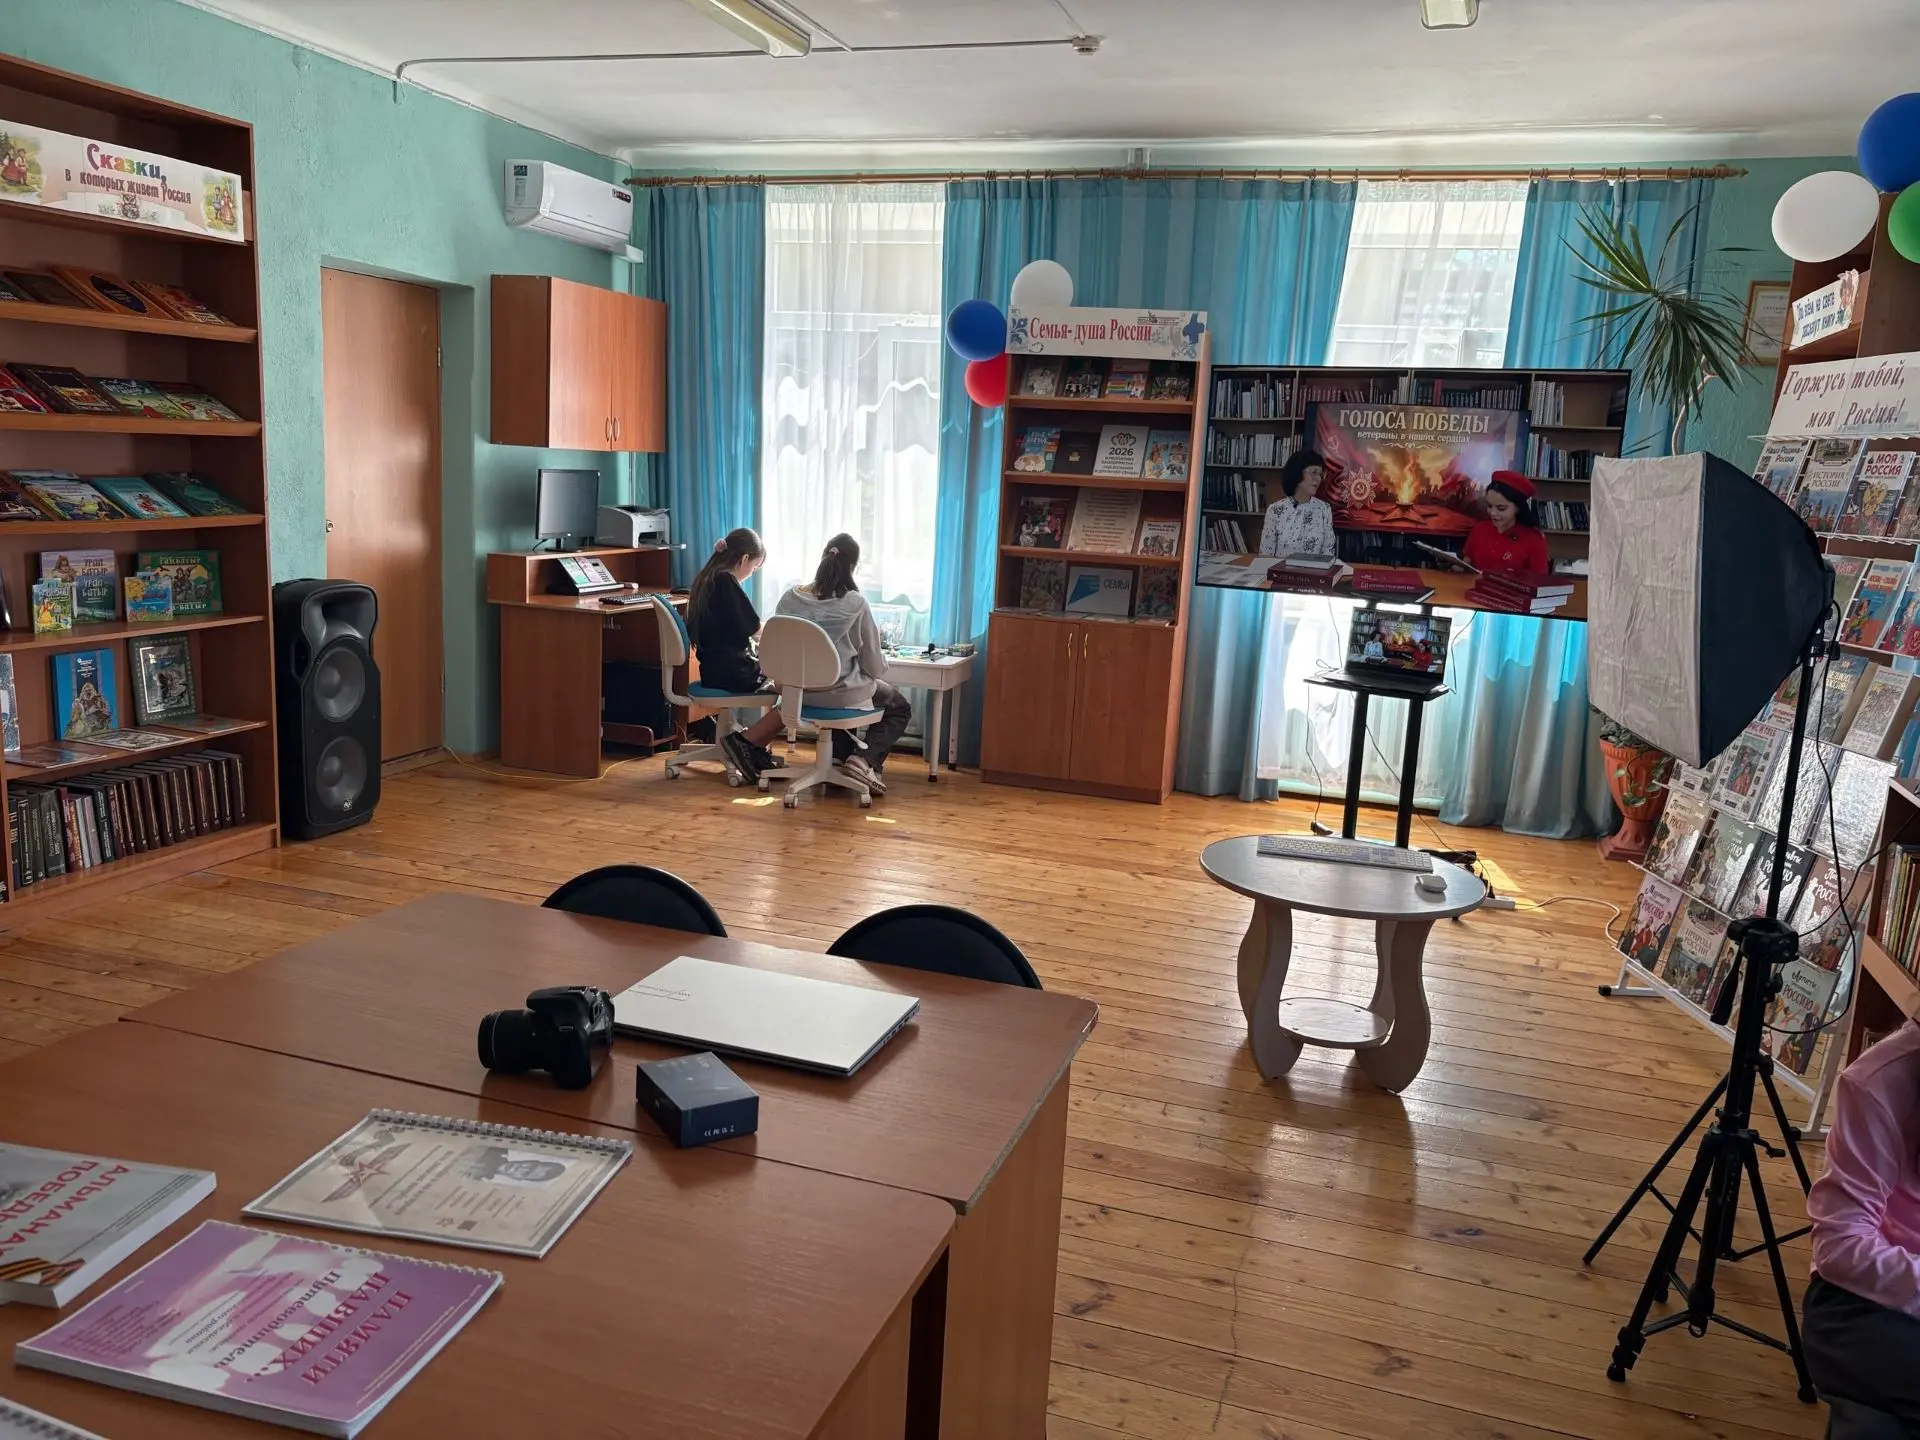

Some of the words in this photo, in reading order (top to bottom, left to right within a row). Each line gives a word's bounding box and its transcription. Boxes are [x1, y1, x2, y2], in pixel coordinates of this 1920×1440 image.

[86, 143, 167, 183] Сказки,
[80, 171, 125, 192] которых
[127, 180, 159, 198] живет
[161, 181, 192, 204] Россия
[1074, 323, 1105, 345] душа
[1109, 319, 1152, 342] России
[1783, 371, 1846, 399] Горжусь
[1850, 360, 1905, 392] тобой,
[1339, 409, 1406, 430] ГОЛОСА
[1412, 412, 1490, 434] ПОБЕДЫ
[1805, 409, 1835, 429] моя
[1843, 398, 1906, 426] Россия!
[1357, 431, 1399, 440] ветераны
[1408, 433, 1435, 442] наших
[1437, 434, 1471, 444] сердцах
[1109, 447, 1134, 456] 2026
[1876, 454, 1898, 464] МОЯ
[1865, 465, 1903, 475] РОССИЯ
[1783, 985, 1813, 1011] РОССИЮ
[213, 1271, 341, 1370] Путеводитель
[301, 1290, 413, 1385] ПАМЯТИ
